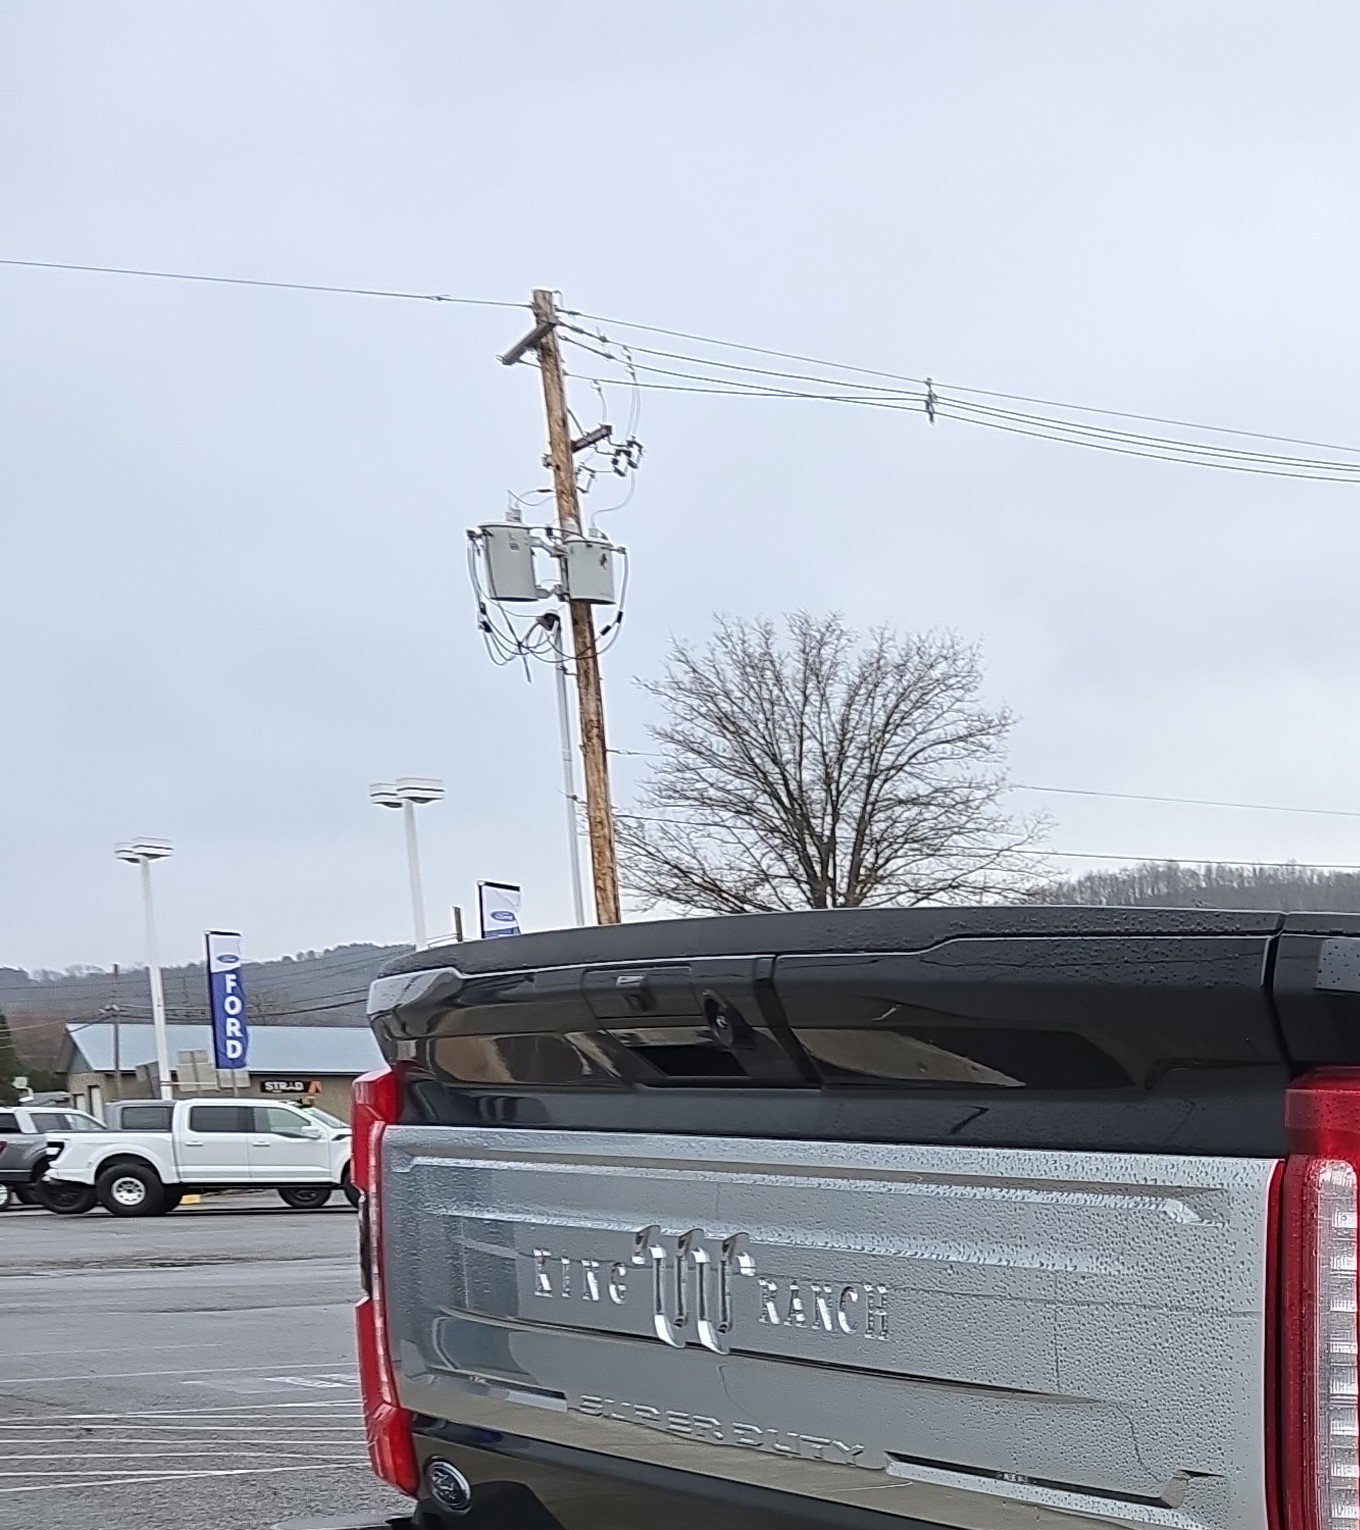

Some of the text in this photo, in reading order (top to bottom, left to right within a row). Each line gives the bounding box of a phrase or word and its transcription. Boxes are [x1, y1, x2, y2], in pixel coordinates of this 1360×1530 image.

[224, 974, 243, 1059] FORD
[533, 1247, 893, 1342] KING RANCH
[579, 1393, 866, 1466] SUPER DUTY
